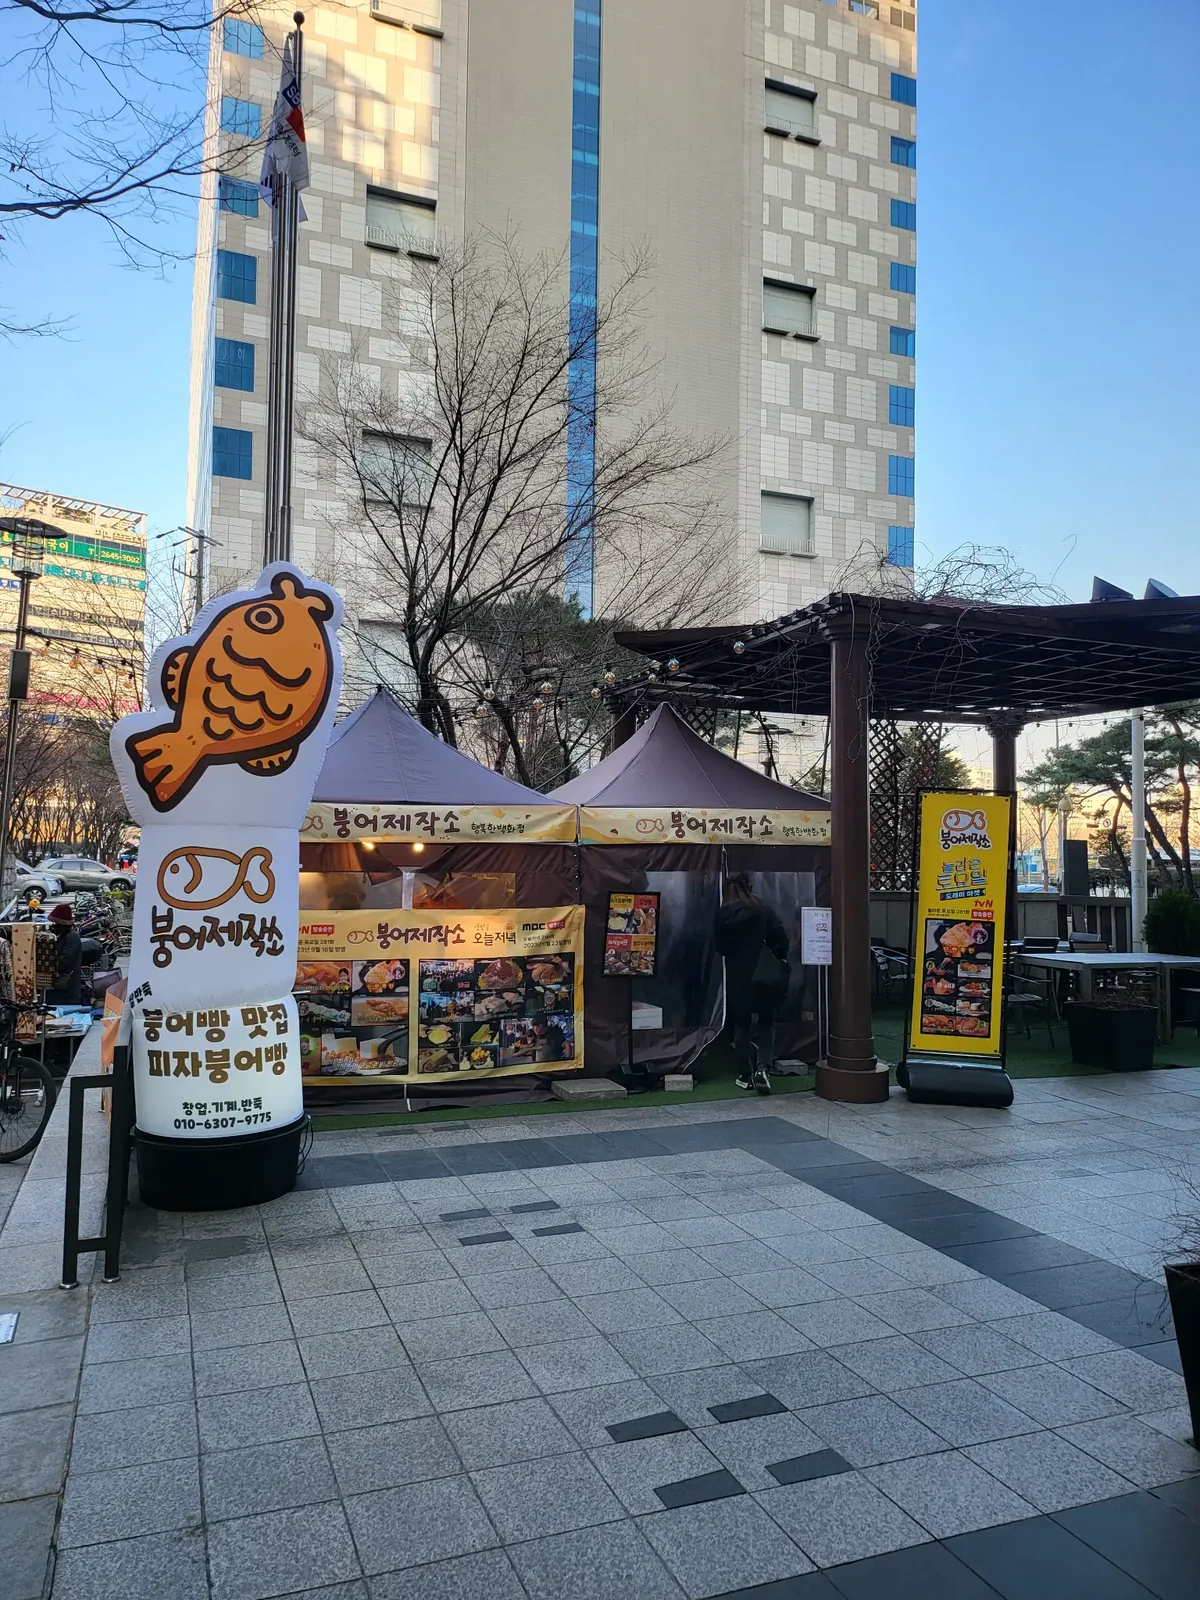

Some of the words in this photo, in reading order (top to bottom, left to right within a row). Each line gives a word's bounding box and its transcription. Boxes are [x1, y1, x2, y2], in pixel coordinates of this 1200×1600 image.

[333, 807, 461, 838] 붕어제작소
[471, 821, 525, 835] 행복한백화점
[670, 811, 774, 839] 붕어제작소
[782, 826, 827, 837] 행복한백화점
[940, 829, 991, 850] 붕어제작소
[974, 900, 993, 908] tvN
[150, 905, 285, 968] 붕어제작소
[376, 922, 466, 949] 붕어제작소
[472, 931, 517, 947] 오늘저녁
[522, 923, 546, 931] MBC
[142, 1008, 231, 1042] 붕어빵
[240, 1003, 289, 1040] 맛집
[147, 1042, 289, 1084] 피자붕어빵
[182, 1097, 264, 1118] 창업.기계.반죽
[173, 1111, 272, 1131] 010-6307-9775
